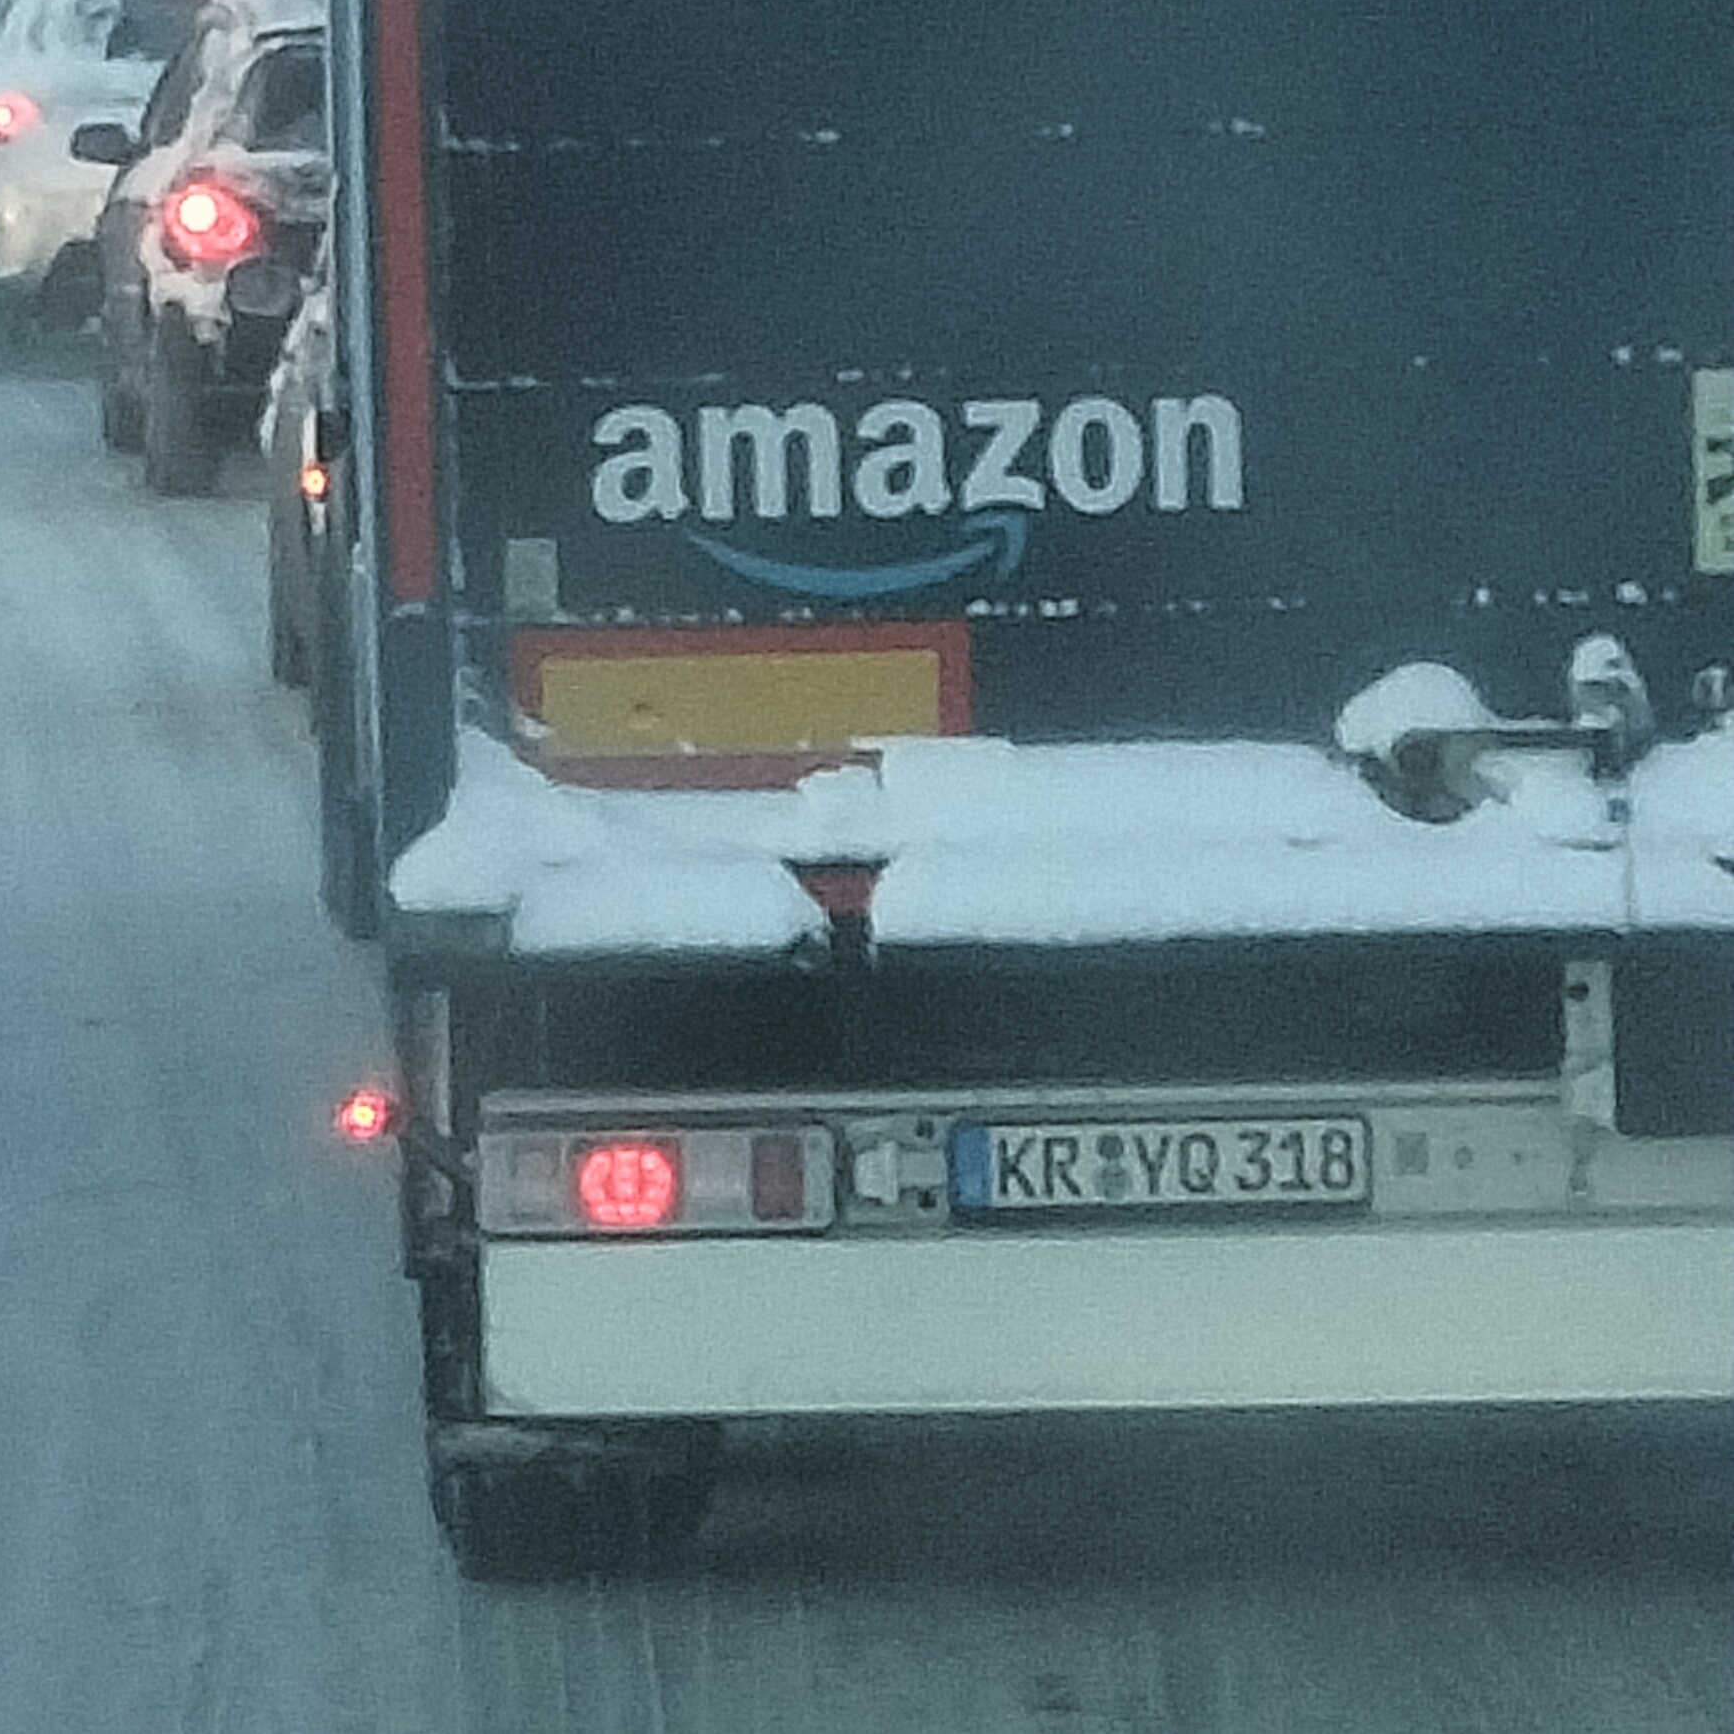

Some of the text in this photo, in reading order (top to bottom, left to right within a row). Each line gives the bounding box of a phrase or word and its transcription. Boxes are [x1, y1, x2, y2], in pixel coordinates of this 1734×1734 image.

[591, 393, 1244, 522] amazon
[996, 1135, 1082, 1198] KR
[1233, 1128, 1355, 1192] 318
